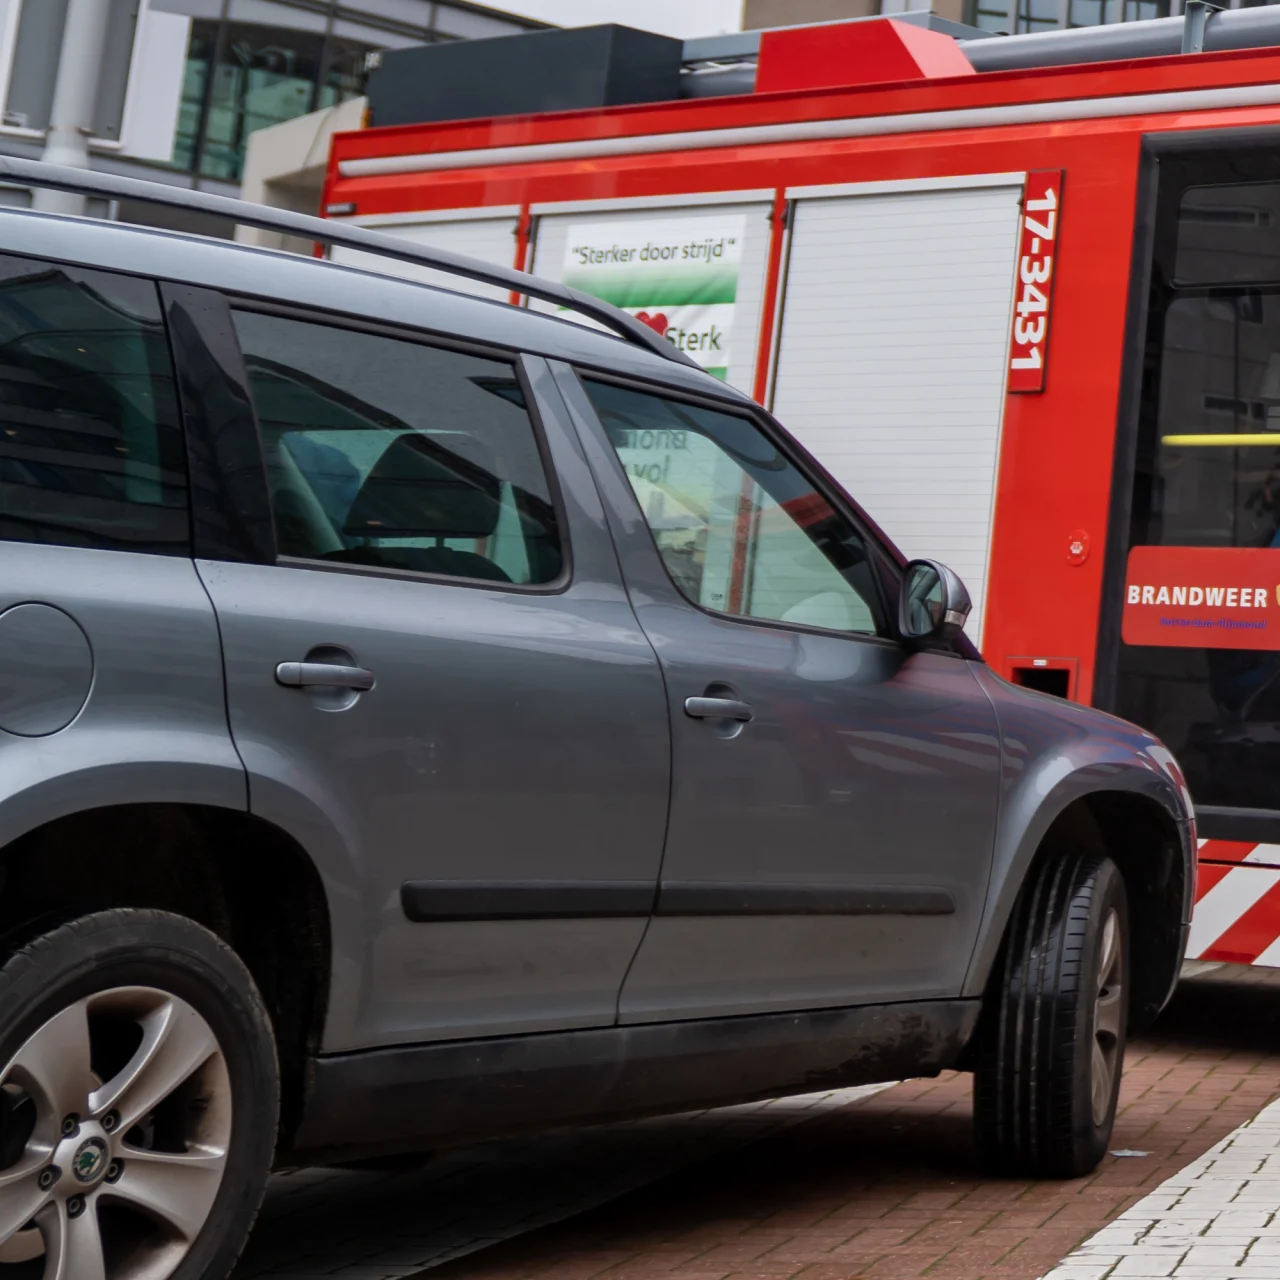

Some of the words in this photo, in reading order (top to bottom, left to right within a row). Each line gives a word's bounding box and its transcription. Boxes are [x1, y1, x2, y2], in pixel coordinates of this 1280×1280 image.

[640, 242, 678, 261] door
[682, 238, 723, 263] strijd
[1011, 188, 1057, 370] 17-3431
[1128, 585, 1267, 608] BRANDWEER
